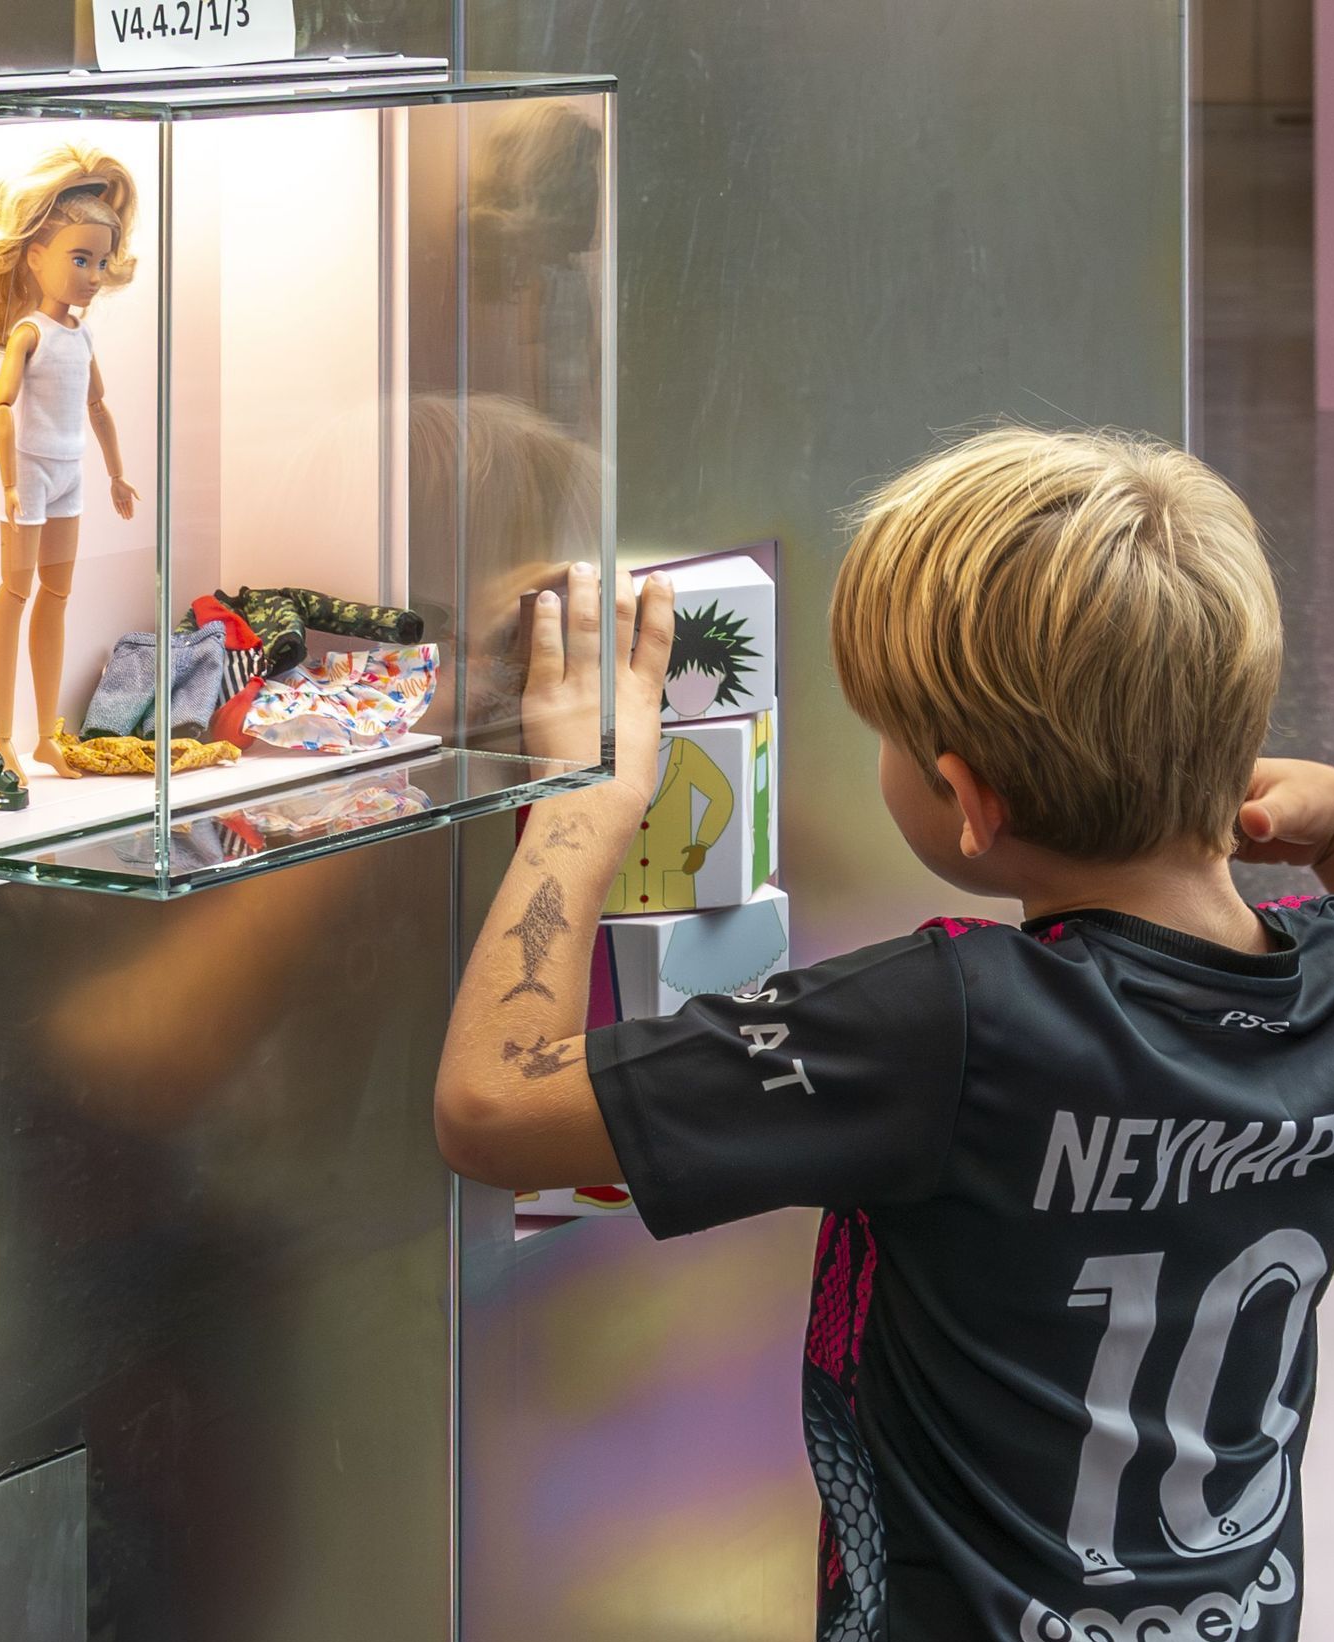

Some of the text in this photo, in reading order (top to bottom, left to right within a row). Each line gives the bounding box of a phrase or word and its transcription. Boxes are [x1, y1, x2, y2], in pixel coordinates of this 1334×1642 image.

[111, 0, 250, 43] V4.4.2/1/3
[1219, 1010, 1290, 1034] PSG
[1066, 1227, 1328, 1586] 10
